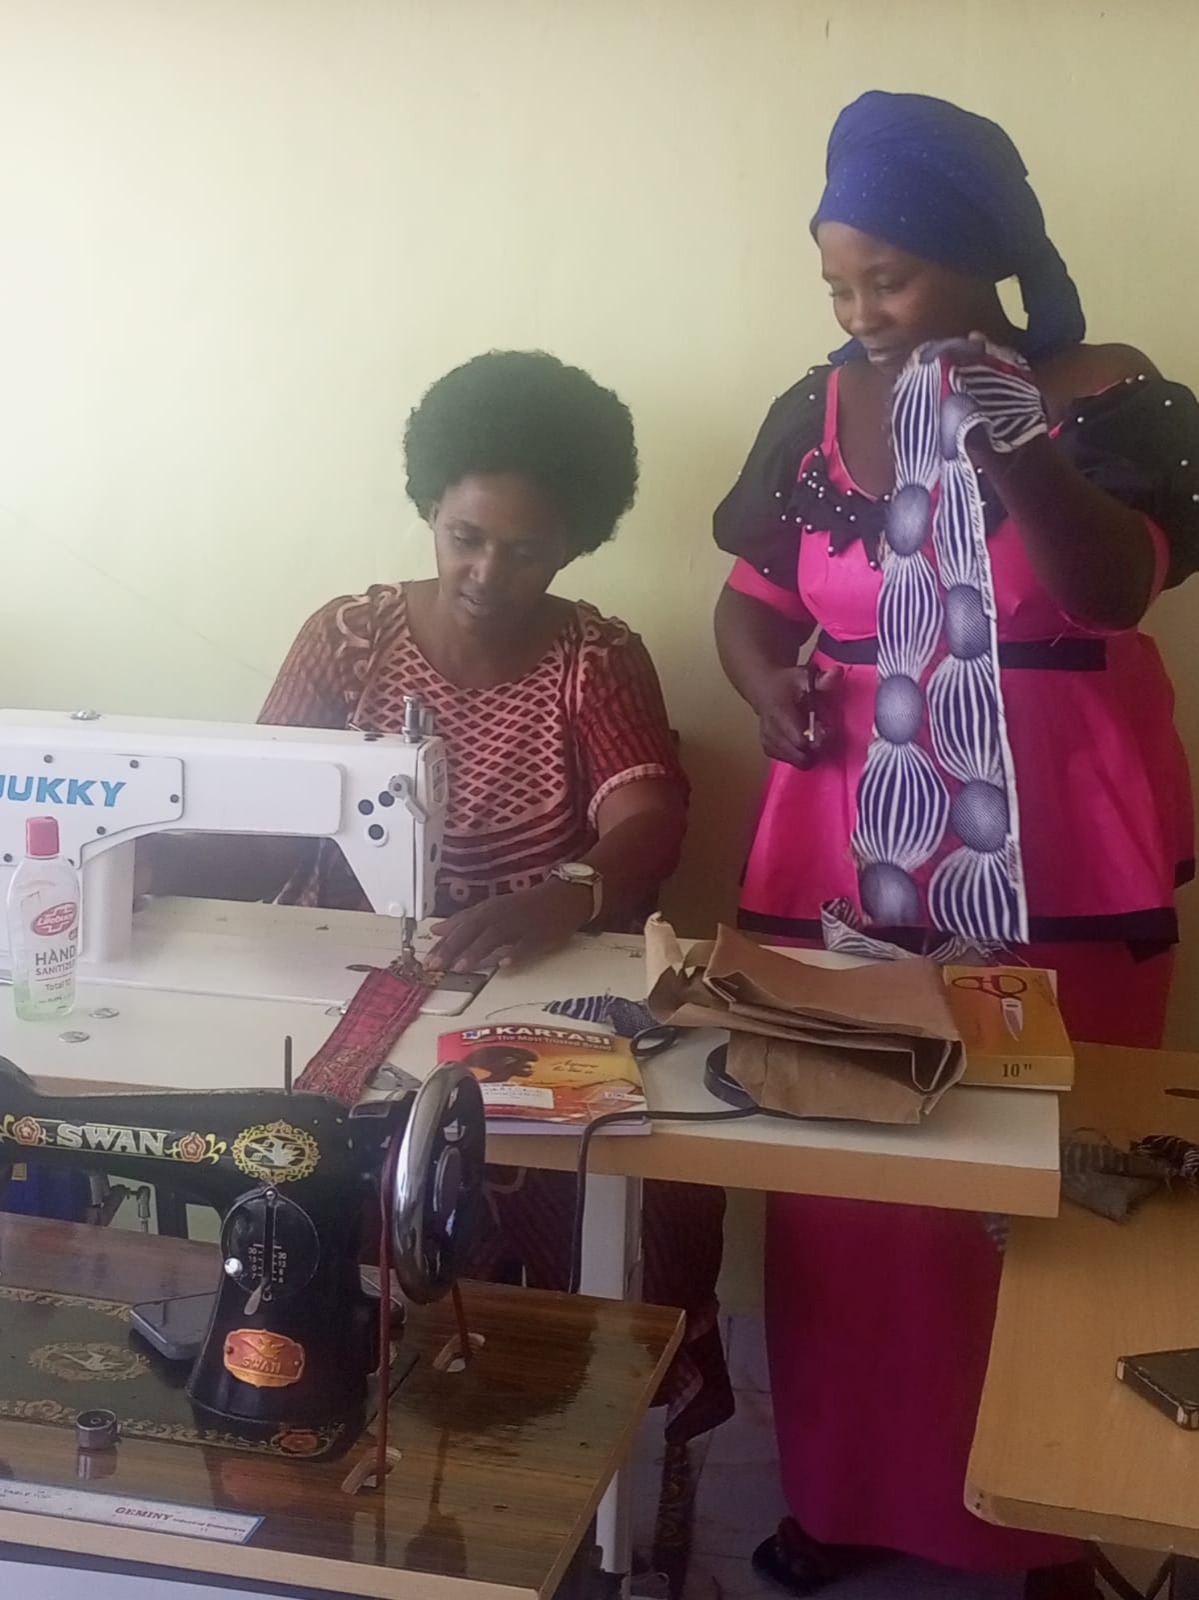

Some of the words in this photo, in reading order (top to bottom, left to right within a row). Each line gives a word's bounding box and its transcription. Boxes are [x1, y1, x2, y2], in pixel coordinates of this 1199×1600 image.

[35, 945, 76, 966] HAND
[496, 1026, 610, 1045] KARTASI
[57, 1123, 168, 1156] SWAN
[241, 1357, 280, 1373] SWAN
[114, 1506, 174, 1521] GEMINY
